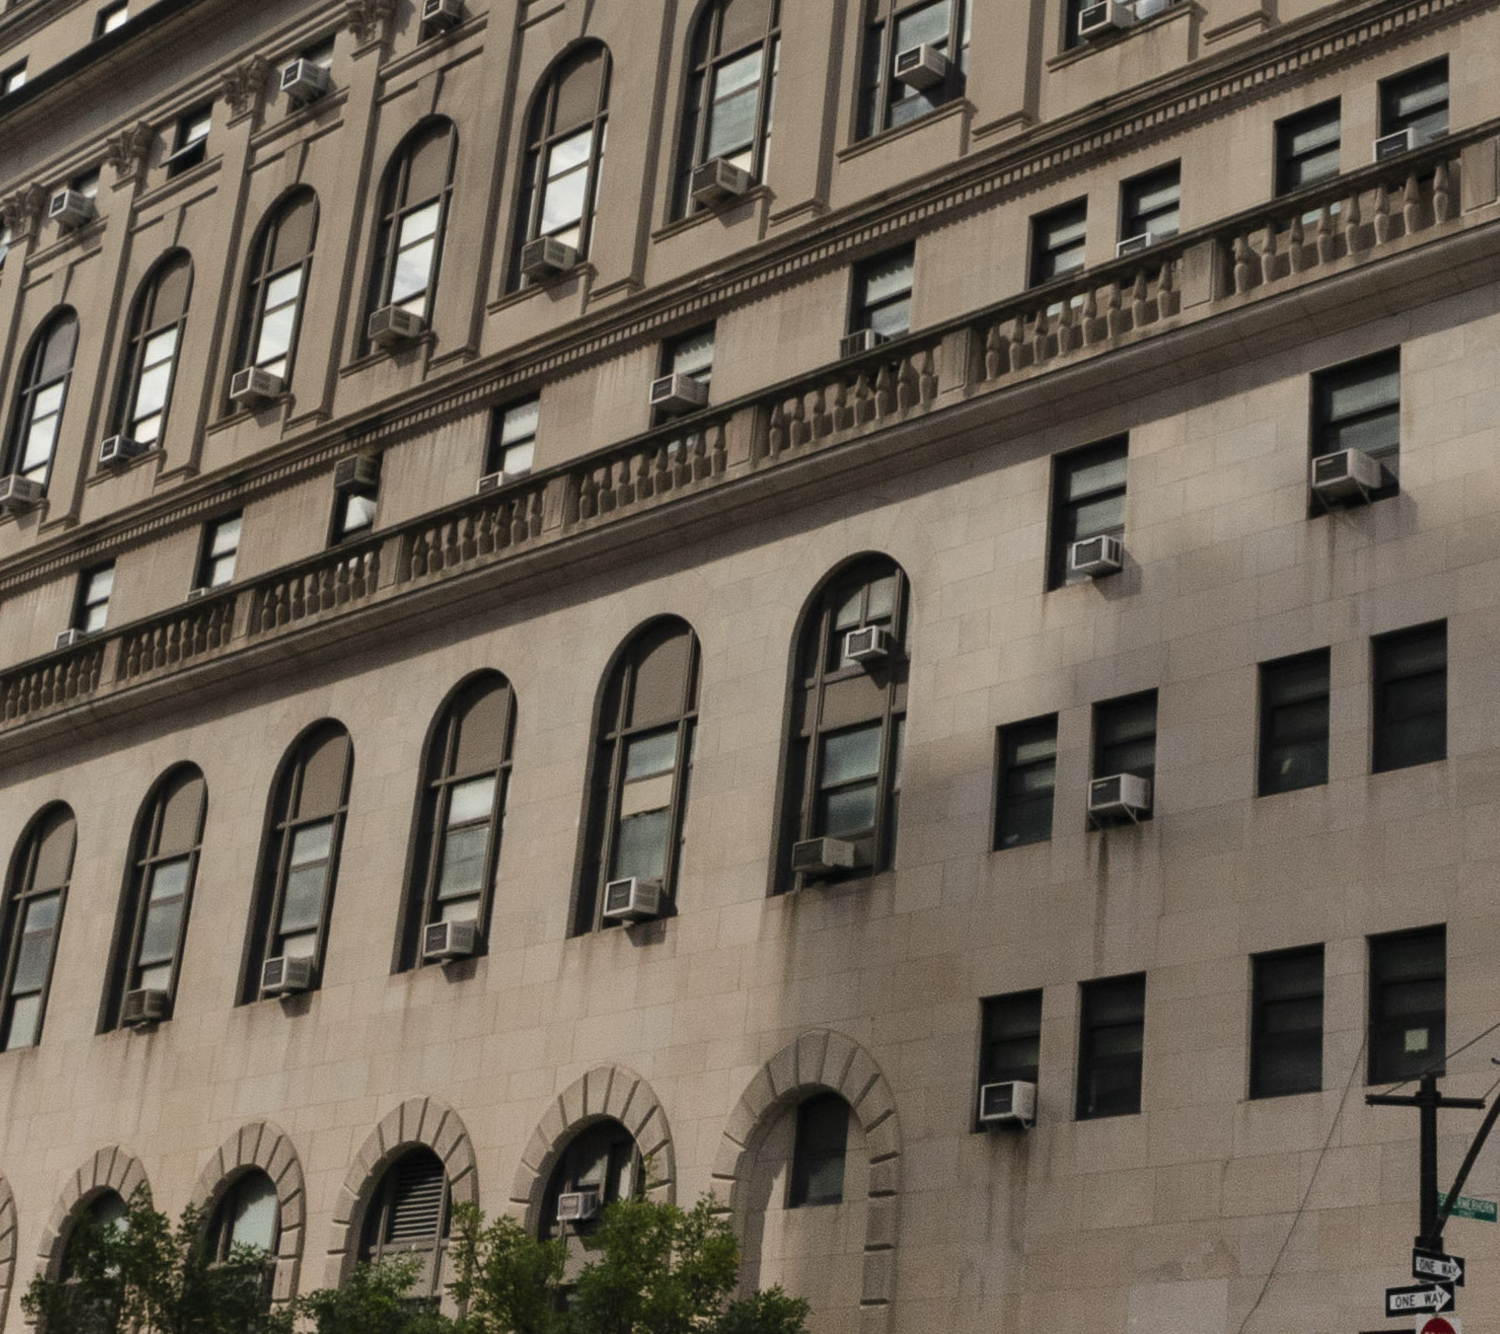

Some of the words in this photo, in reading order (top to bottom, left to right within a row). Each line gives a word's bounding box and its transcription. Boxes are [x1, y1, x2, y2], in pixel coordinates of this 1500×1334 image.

[1419, 1258, 1435, 1273] ONE
[1441, 1260, 1458, 1277] WAY
[1395, 1294, 1415, 1308] ONE
[1424, 1291, 1445, 1306] WAY
